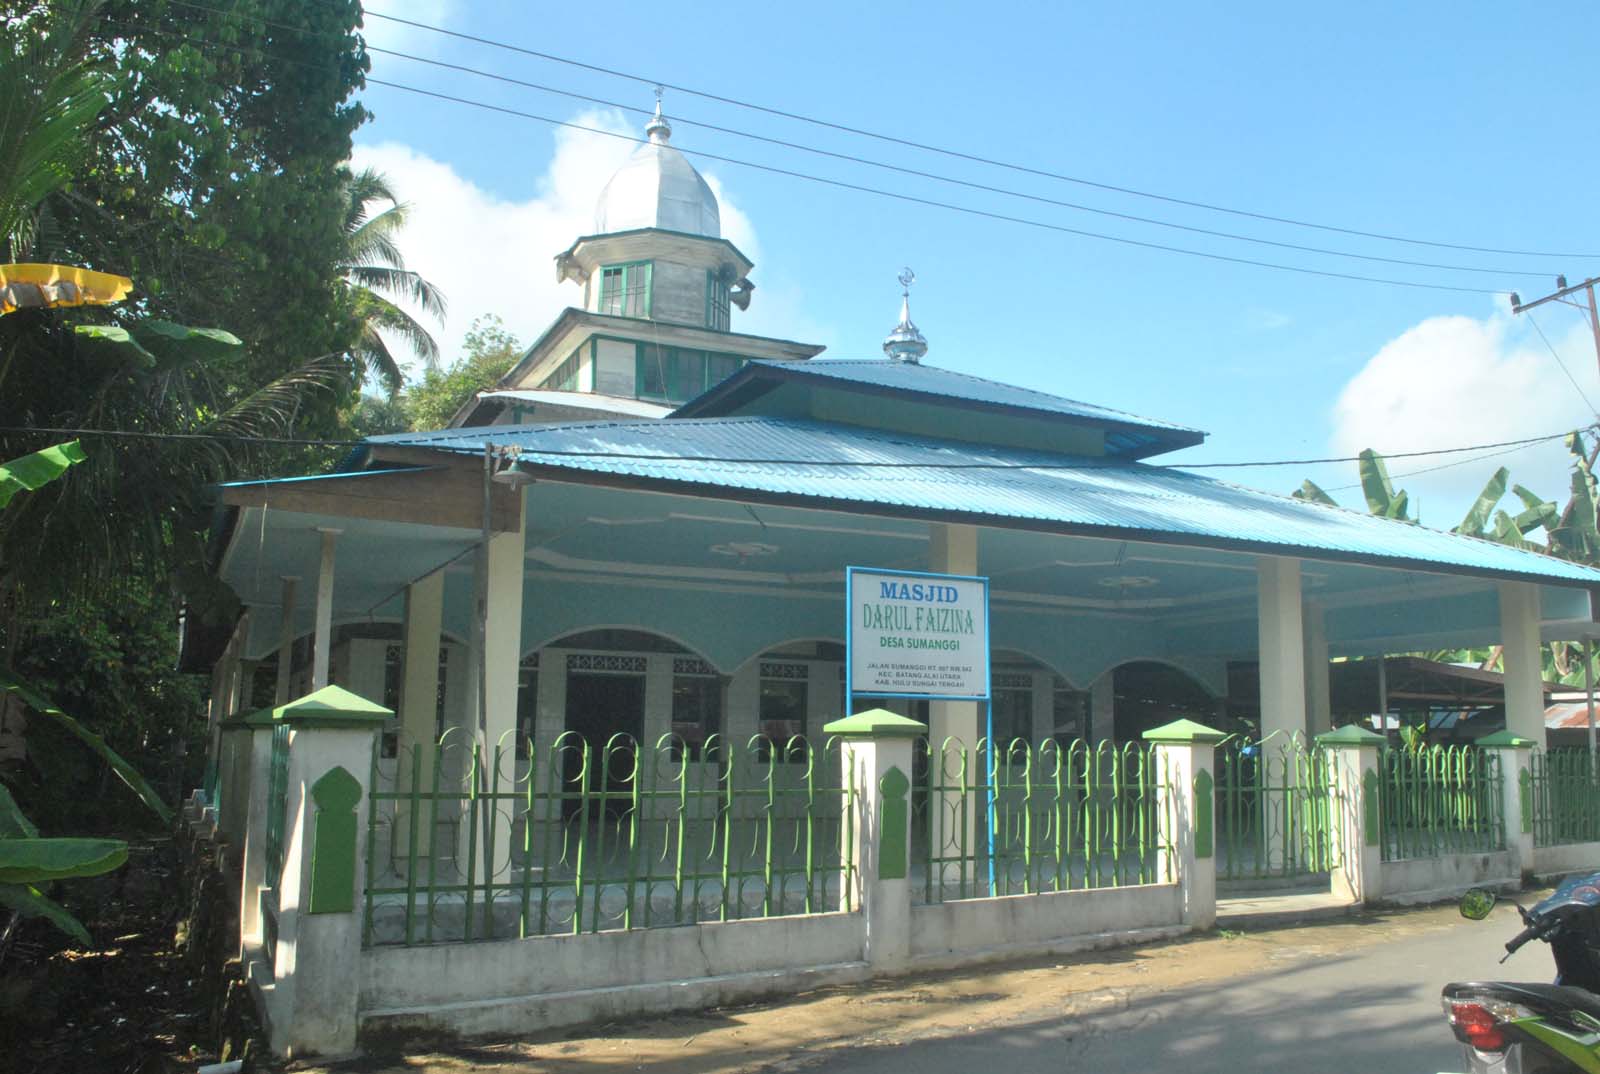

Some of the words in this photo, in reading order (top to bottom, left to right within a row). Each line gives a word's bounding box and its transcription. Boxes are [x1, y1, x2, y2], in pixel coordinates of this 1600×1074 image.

[880, 582, 958, 603] MASJID
[863, 603, 912, 631] DARUL
[916, 607, 974, 634] FAIZINA
[880, 637, 904, 648] DESA
[907, 638, 960, 651] SUMANGGI
